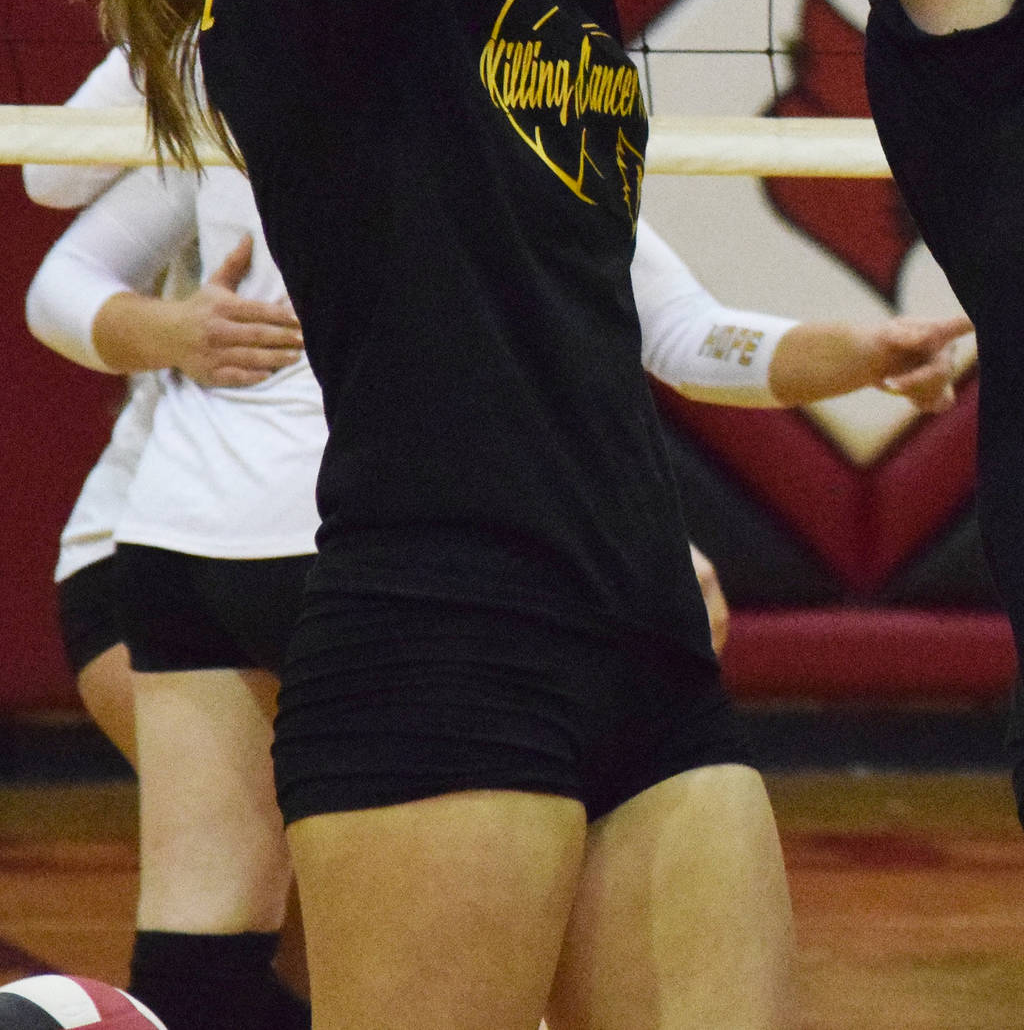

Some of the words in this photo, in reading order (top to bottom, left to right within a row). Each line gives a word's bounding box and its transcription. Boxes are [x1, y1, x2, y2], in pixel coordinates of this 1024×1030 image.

[480, 38, 574, 127] Killing
[575, 34, 641, 120] Cancer
[698, 324, 764, 366] HOPE
